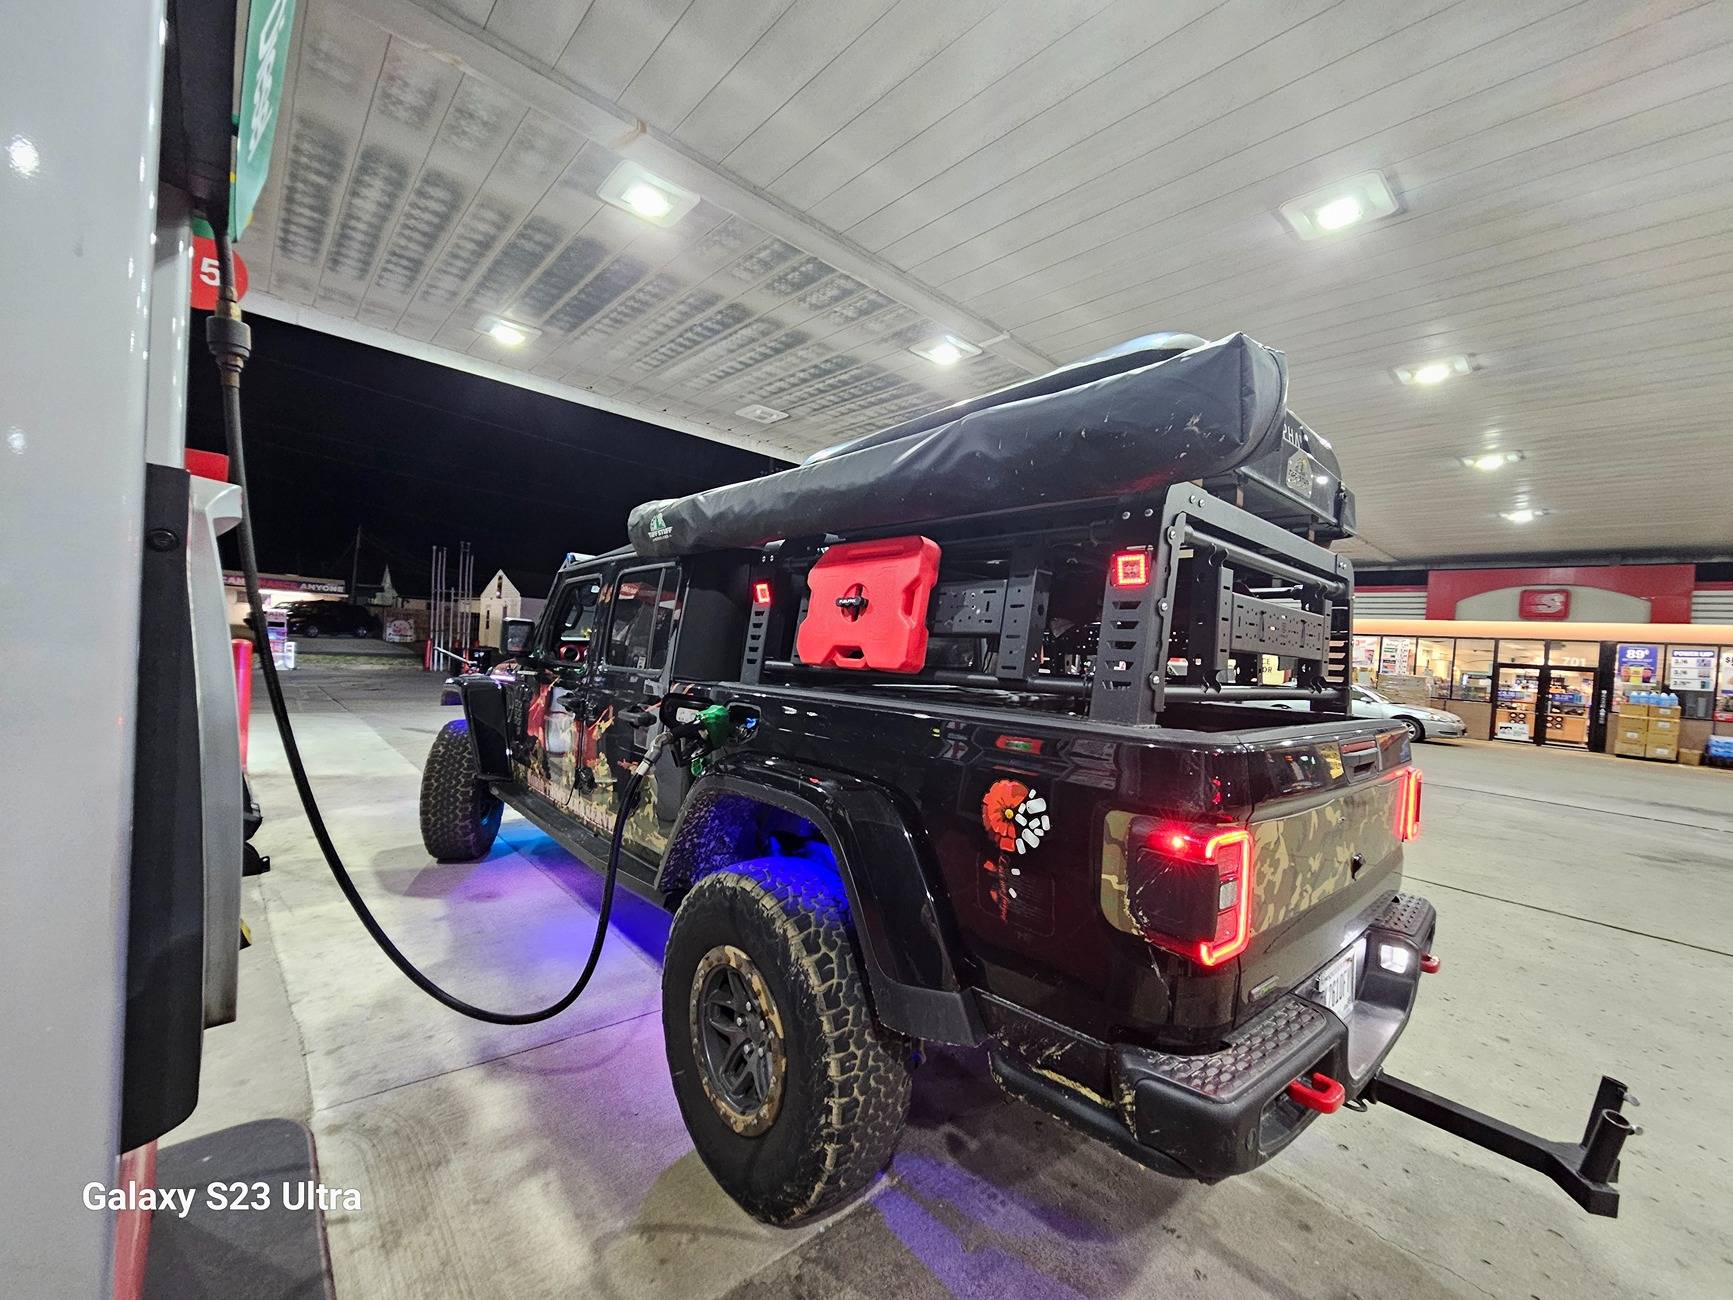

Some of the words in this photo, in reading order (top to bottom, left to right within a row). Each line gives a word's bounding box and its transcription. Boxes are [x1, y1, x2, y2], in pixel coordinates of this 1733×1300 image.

[199, 256, 221, 286] 5
[299, 582, 344, 592] ANYONE
[1561, 656, 1587, 667] 701
